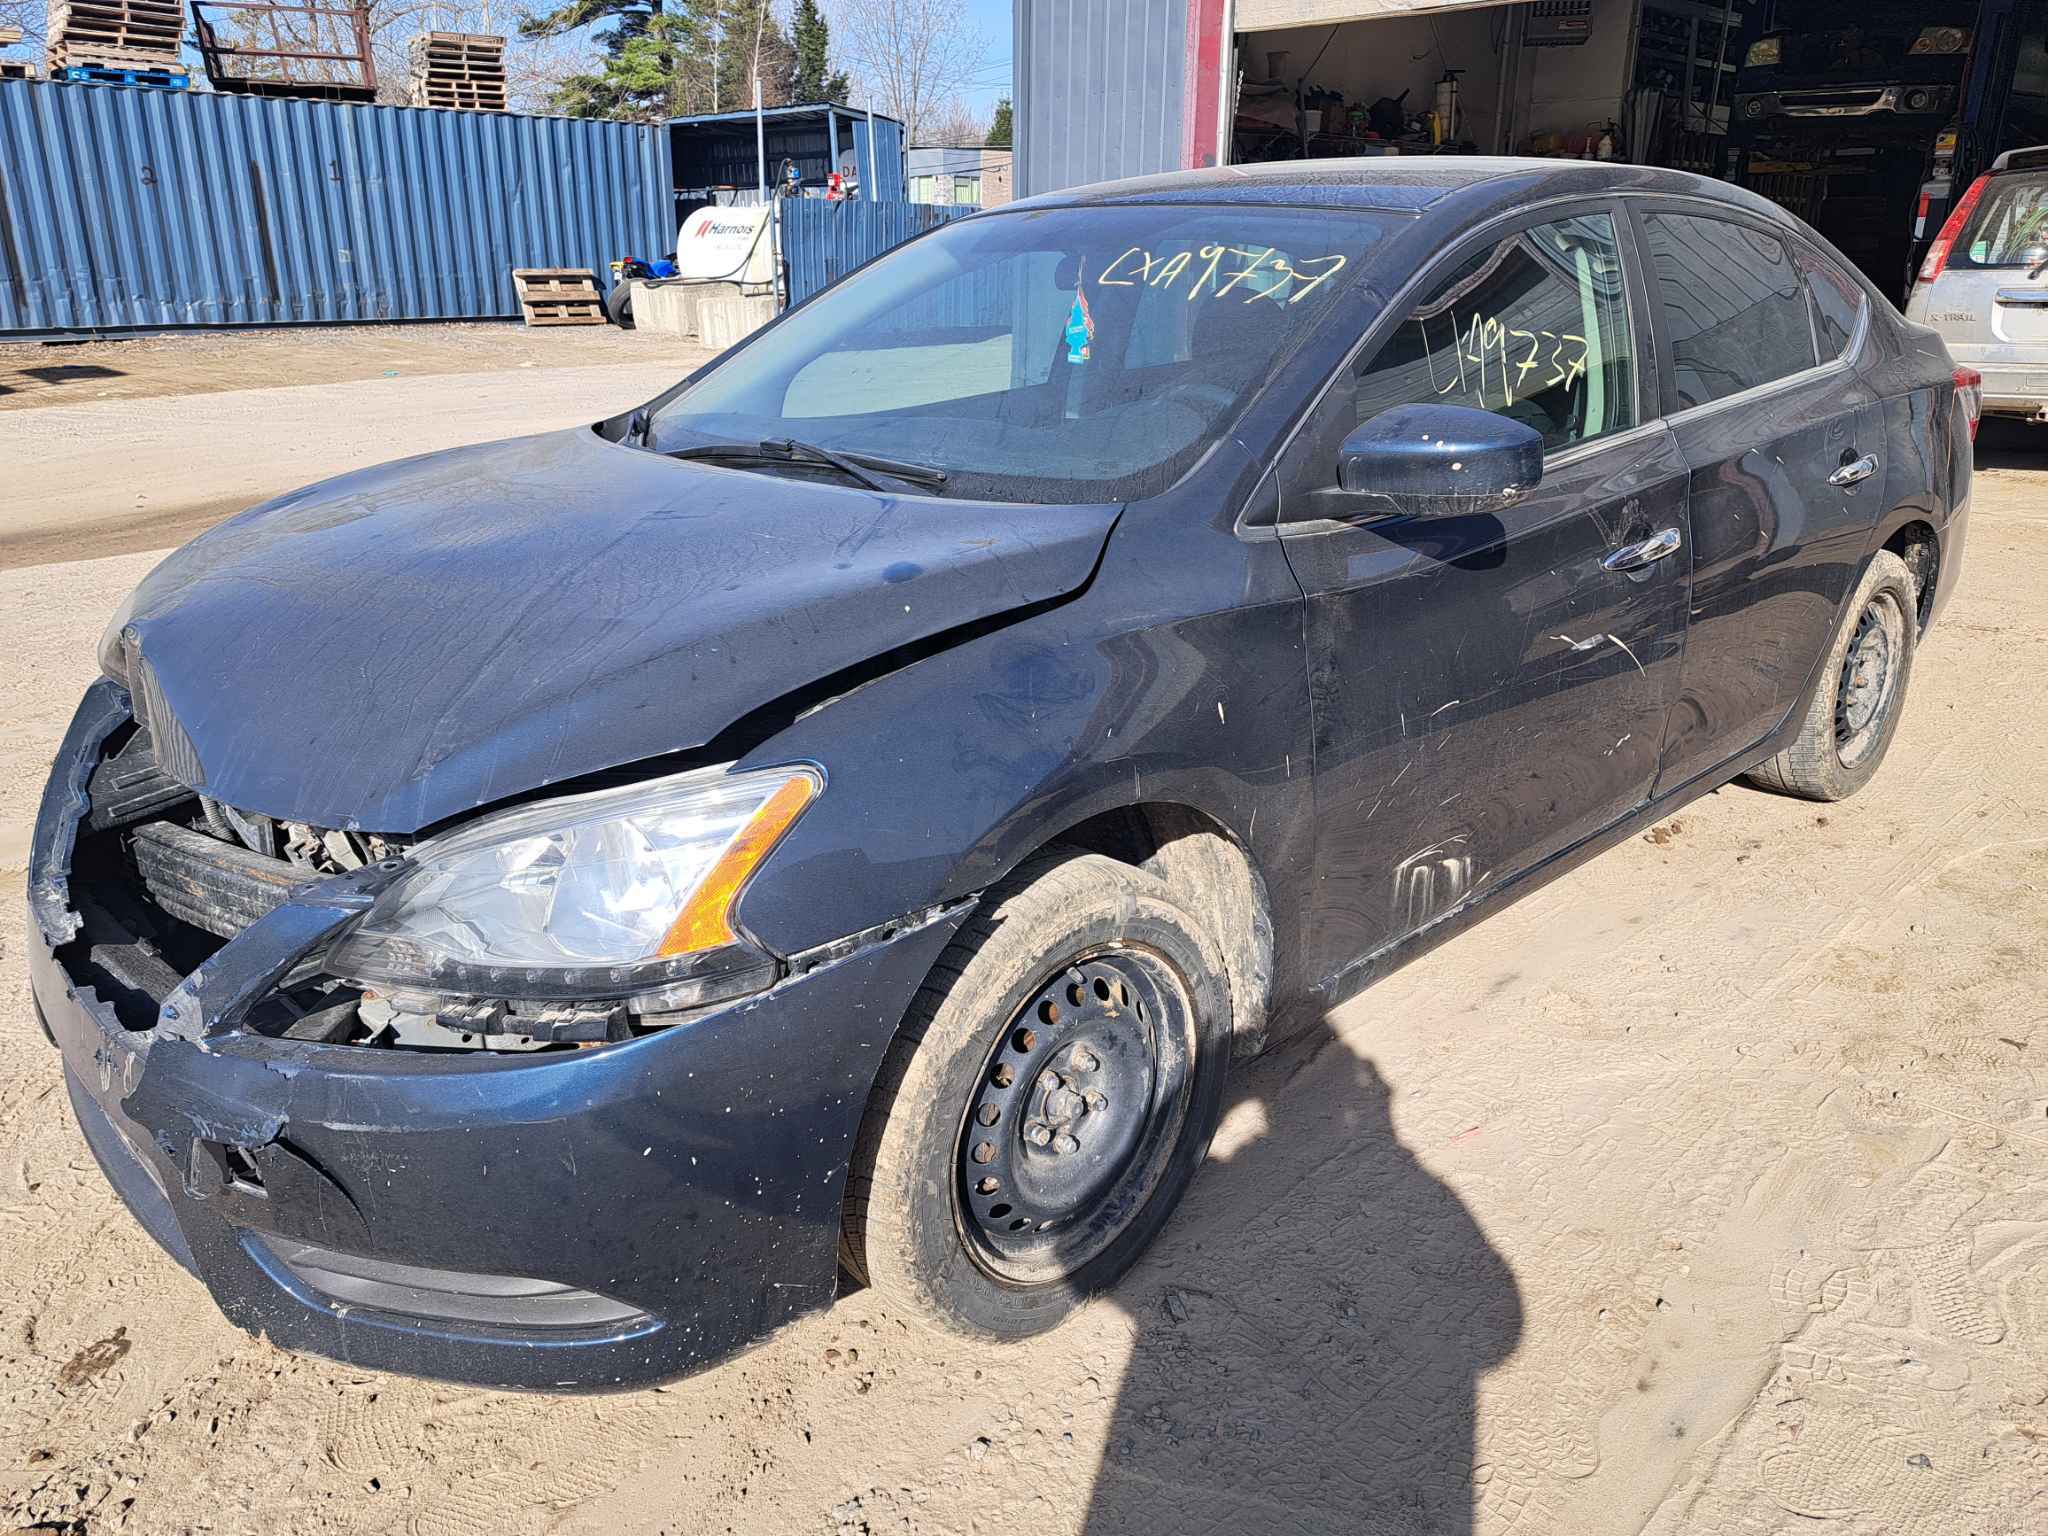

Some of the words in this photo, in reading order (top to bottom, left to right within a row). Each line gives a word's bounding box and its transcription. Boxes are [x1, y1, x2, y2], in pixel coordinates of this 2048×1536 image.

[141, 165, 158, 186] 2
[329, 160, 344, 181] 1
[709, 222, 754, 235] Harnois
[1929, 312, 1977, 322] X-TRAIL
